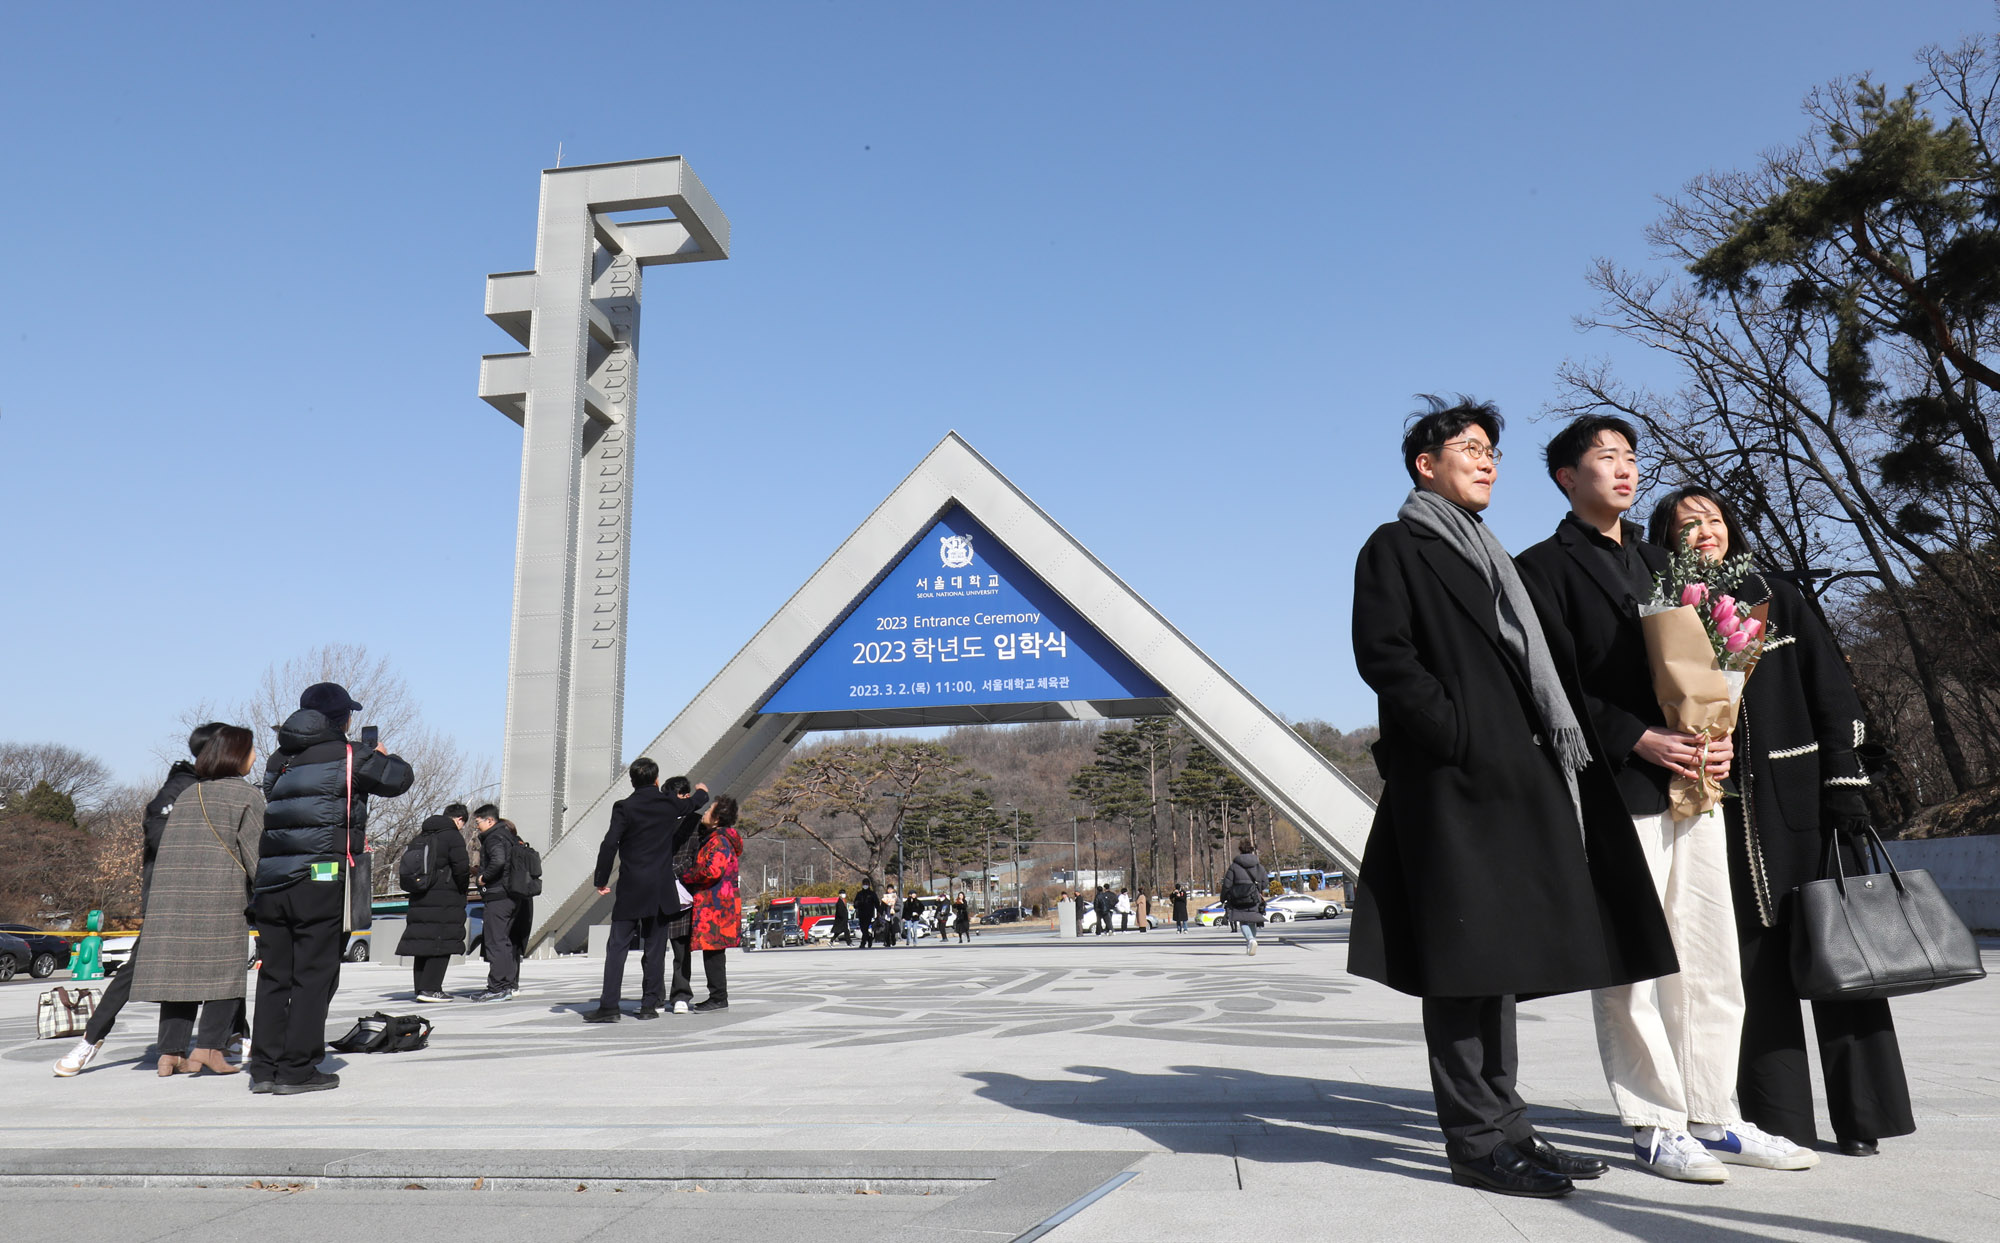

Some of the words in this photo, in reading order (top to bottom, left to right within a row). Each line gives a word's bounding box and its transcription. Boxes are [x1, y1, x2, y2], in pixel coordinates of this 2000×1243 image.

[916, 574, 999, 590] 서울대학교
[966, 589, 999, 597] UNIVERSITY
[876, 616, 908, 631] 2023
[914, 615, 970, 628] Entrance
[974, 612, 1041, 626] Ceremony
[853, 640, 907, 665] 2023
[911, 636, 986, 664] 학년도
[993, 631, 1067, 660] 입학식
[935, 680, 976, 693] 11:00,
[981, 678, 1036, 692] 서울대학교
[1037, 676, 1070, 689] 체육관
